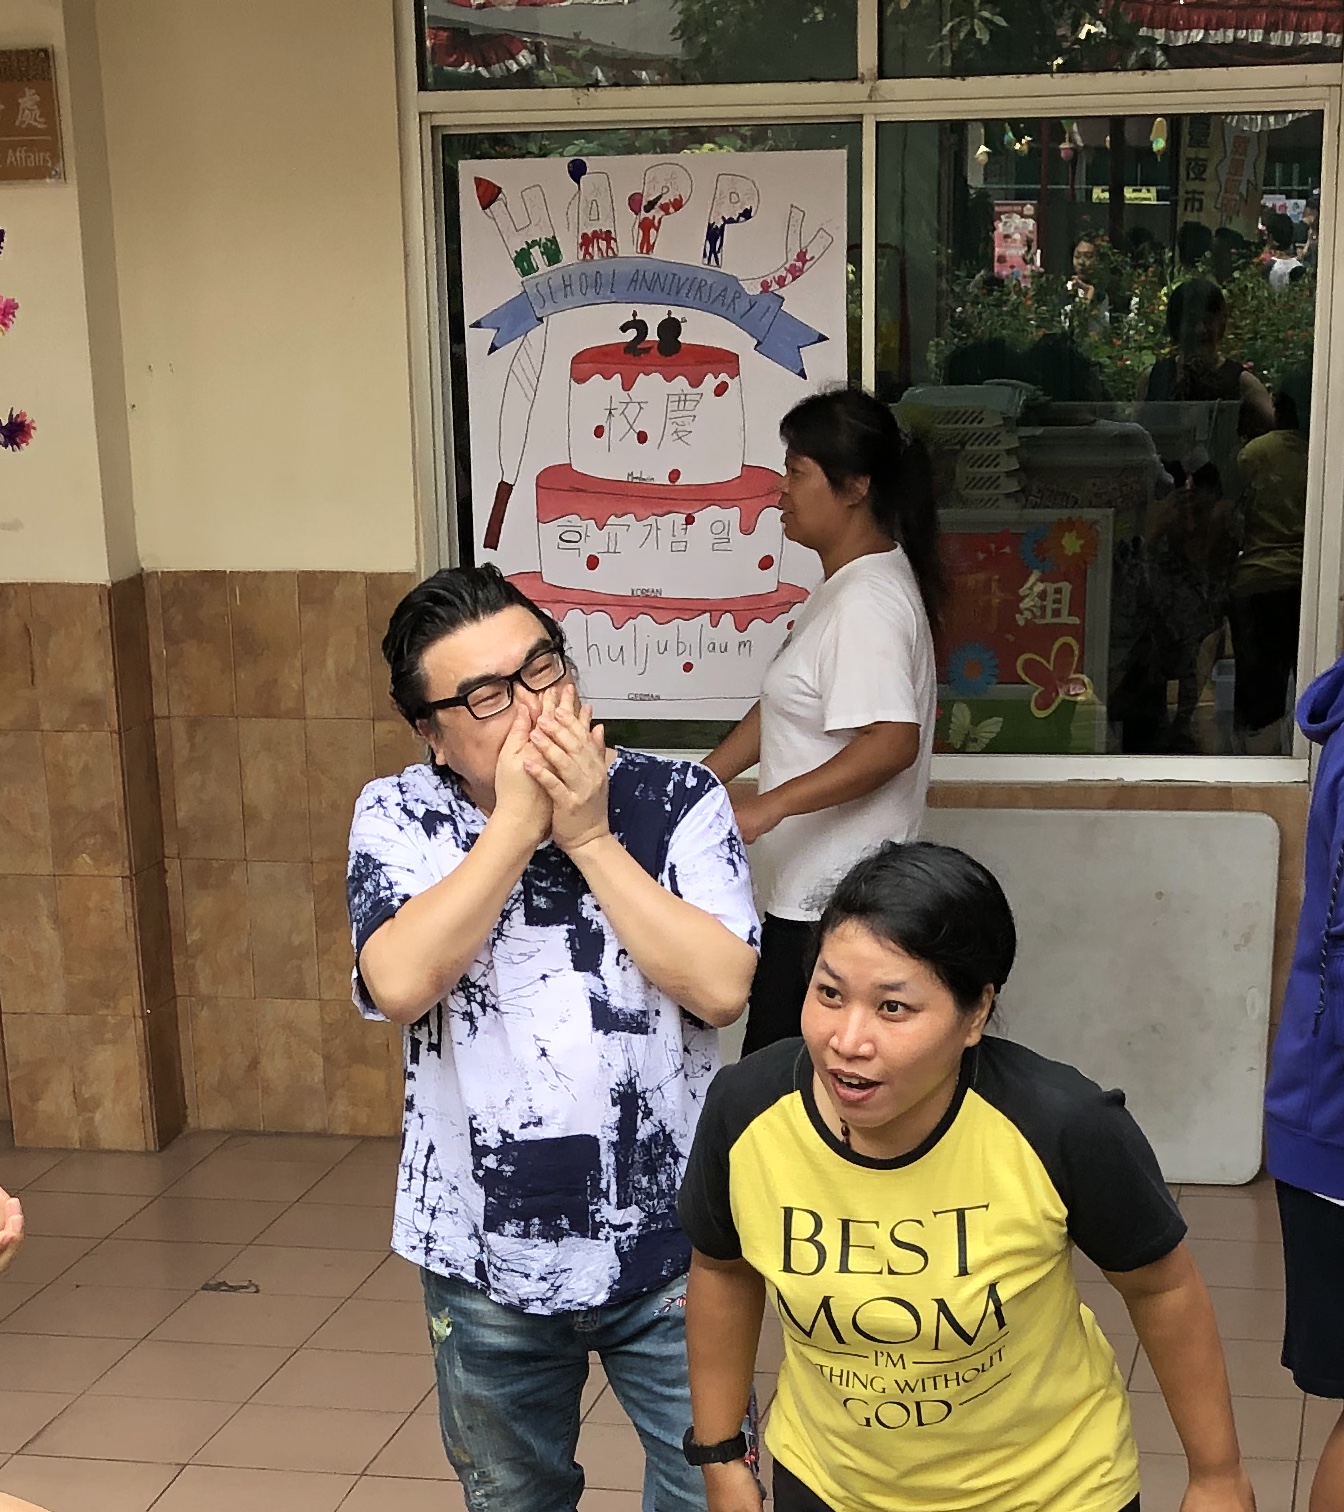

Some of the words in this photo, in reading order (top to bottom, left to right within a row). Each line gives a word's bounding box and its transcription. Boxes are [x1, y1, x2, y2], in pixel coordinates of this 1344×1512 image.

[6, 147, 52, 168] Affairs
[488, 162, 834, 294] HAPPY
[534, 268, 617, 310] SCHOOL
[618, 315, 682, 358] 28
[603, 388, 704, 453] 校慶
[1016, 569, 1081, 627] 組
[777, 1202, 991, 1278] BEST
[776, 1281, 1009, 1351] MOM
[873, 1349, 907, 1370] I'M
[893, 1345, 1007, 1395] WITHOUT
[842, 1396, 954, 1430] GOD
